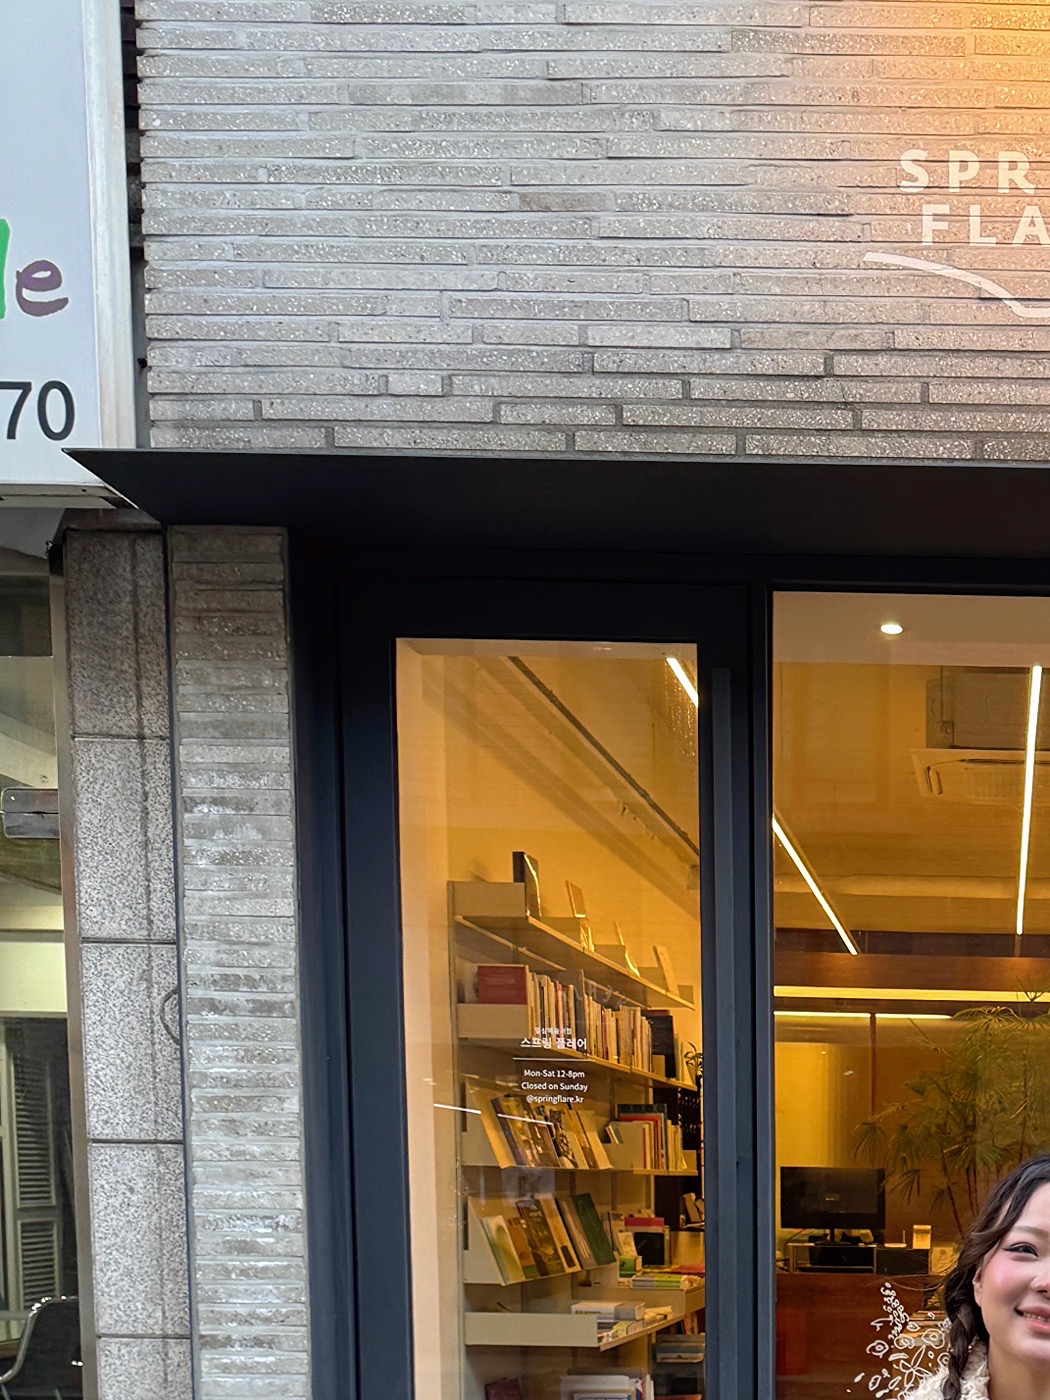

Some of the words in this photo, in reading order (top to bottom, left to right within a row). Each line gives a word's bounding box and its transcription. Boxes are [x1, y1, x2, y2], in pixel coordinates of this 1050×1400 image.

[520, 1037, 552, 1049] 스프링
[556, 1037, 587, 1050] 플레어
[524, 1069, 555, 1078] Mon-Sat
[557, 1070, 585, 1079] 12-8pm
[521, 1082, 547, 1090] Closed
[560, 1083, 588, 1092] Sunday
[526, 1095, 584, 1104] @springflare.kr
